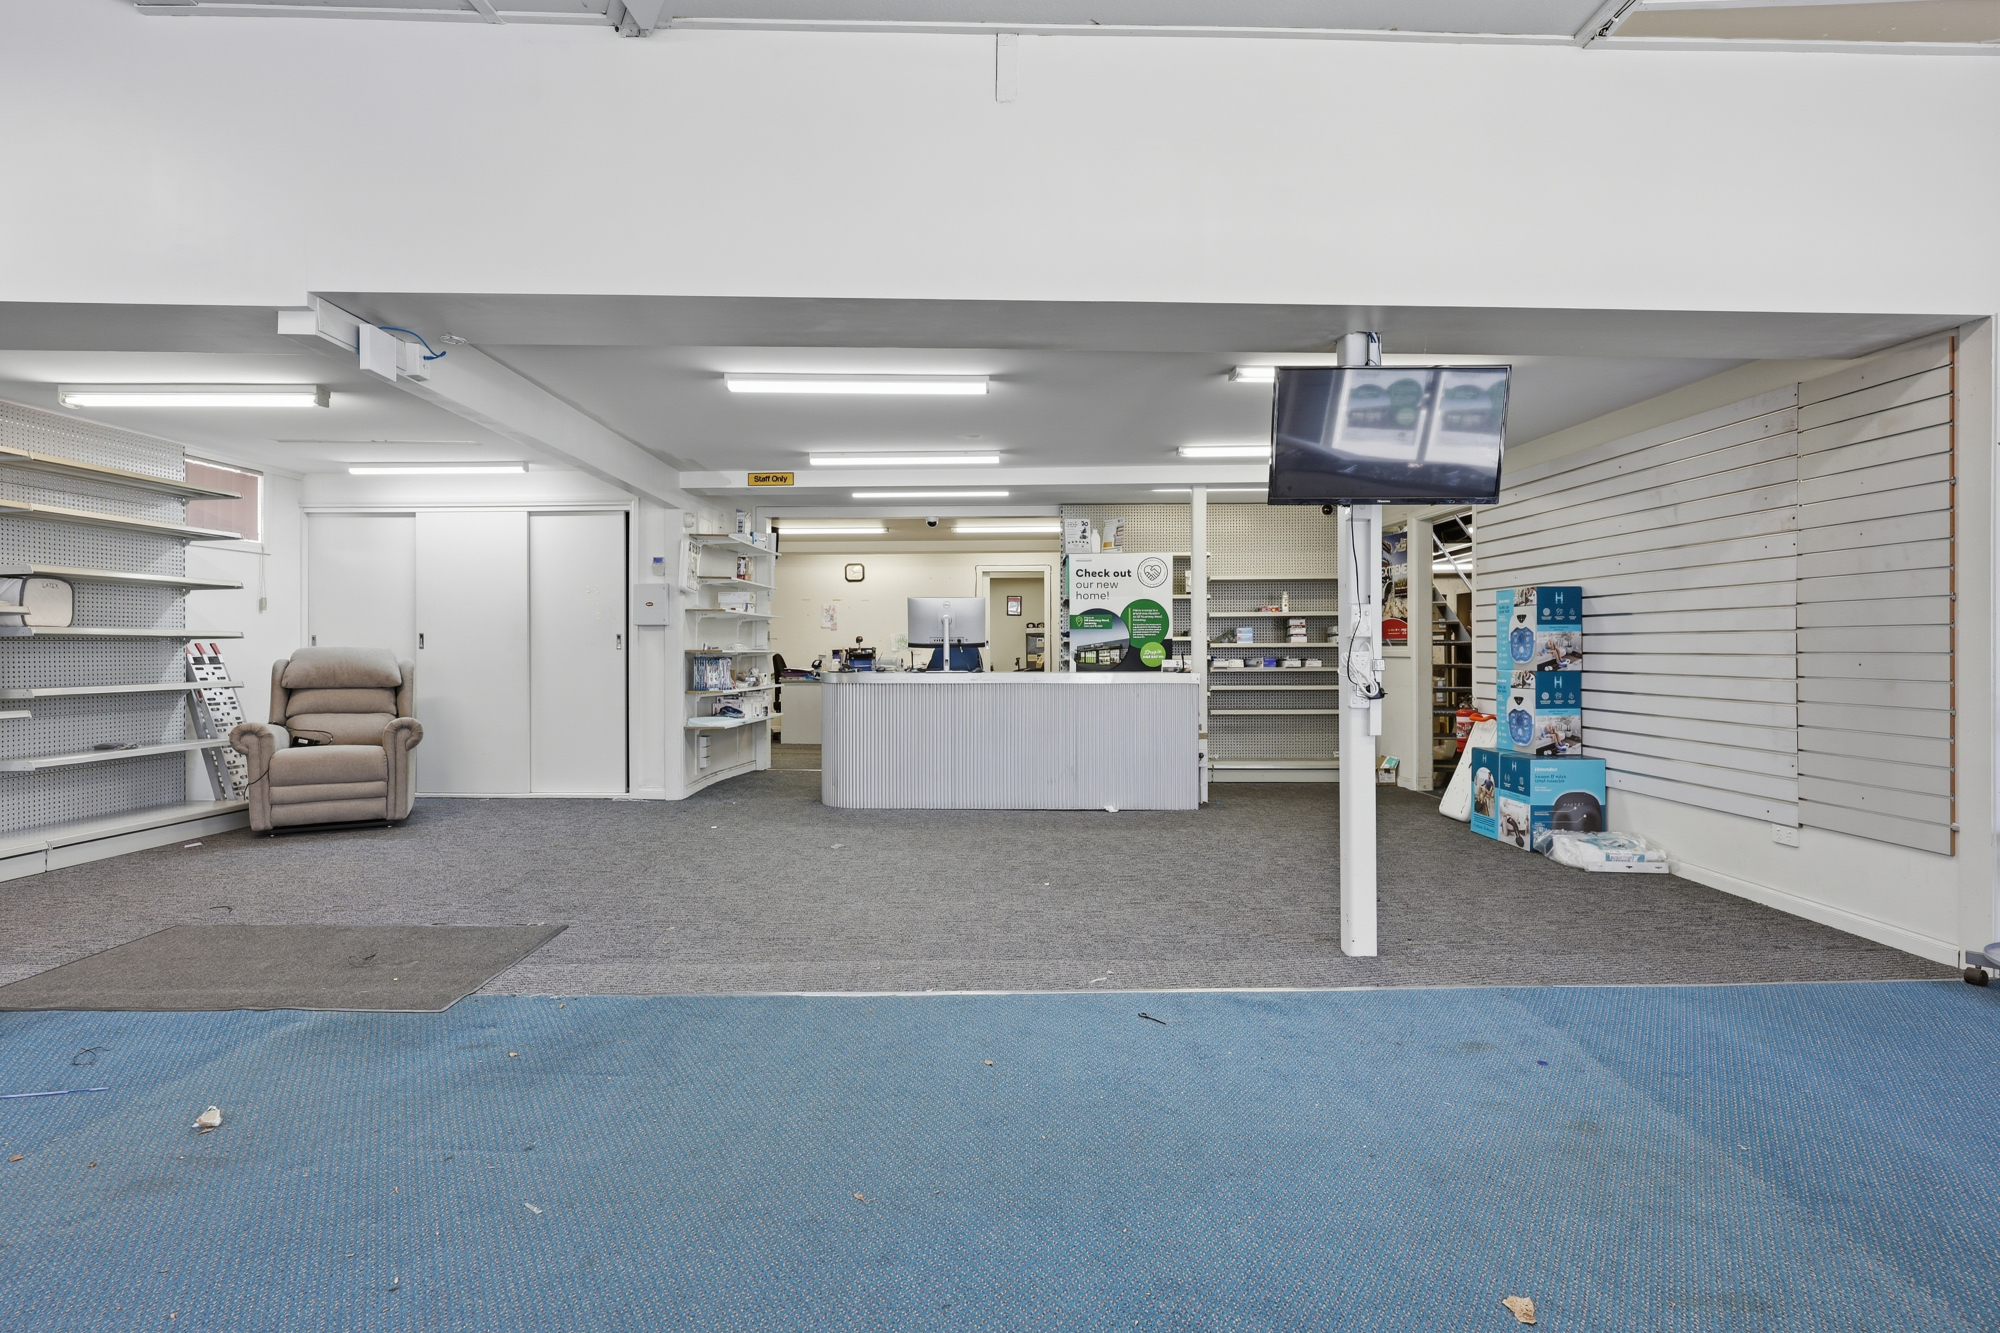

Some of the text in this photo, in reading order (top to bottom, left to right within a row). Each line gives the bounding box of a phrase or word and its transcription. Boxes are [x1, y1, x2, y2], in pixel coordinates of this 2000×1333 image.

[1075, 568, 1132, 578] Check out
[1075, 581, 1119, 589] our new
[1075, 590, 1110, 600] home!
